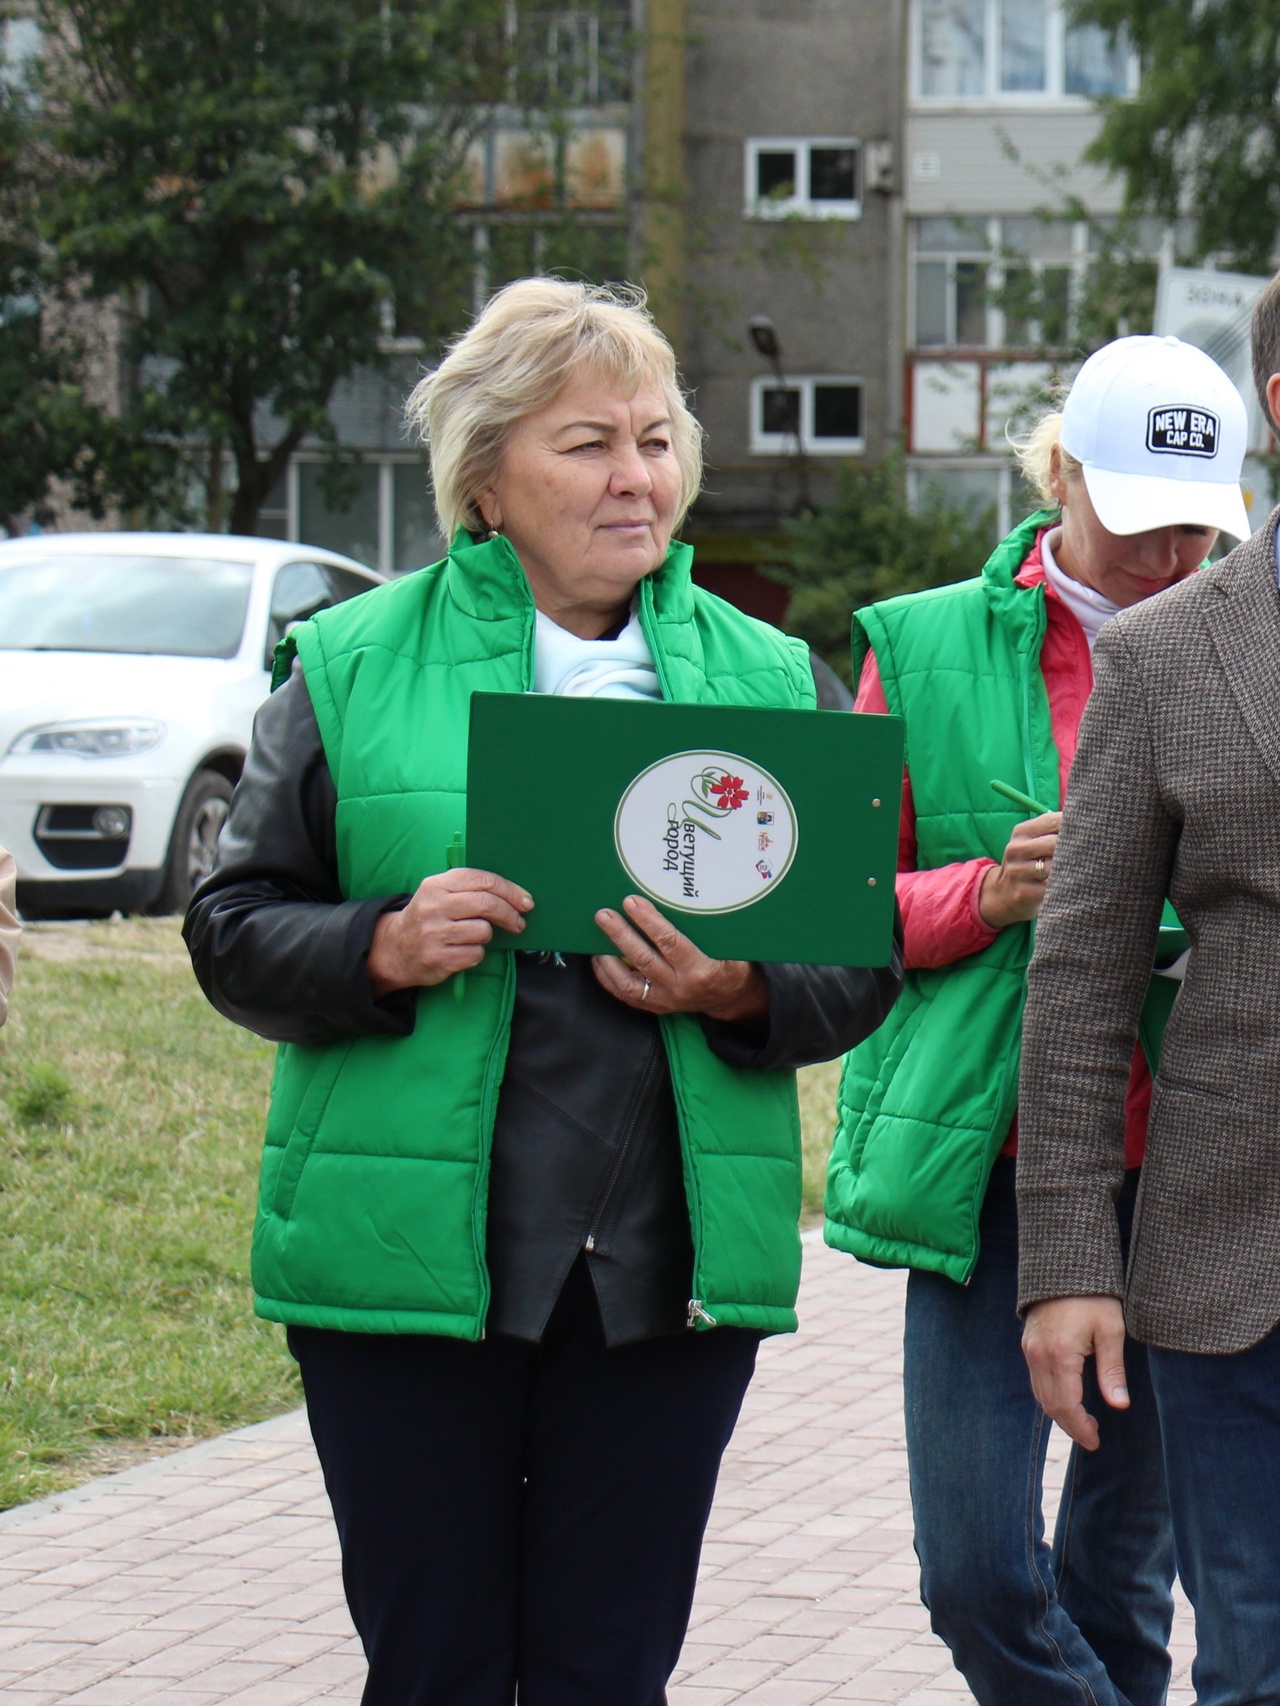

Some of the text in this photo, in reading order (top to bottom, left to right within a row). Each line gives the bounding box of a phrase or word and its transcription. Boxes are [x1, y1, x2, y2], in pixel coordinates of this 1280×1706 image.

[1155, 410, 1214, 437] NEW ERA
[1166, 430, 1205, 448] CAP CO.
[663, 820, 679, 871] город
[678, 800, 721, 898] Цветущий
